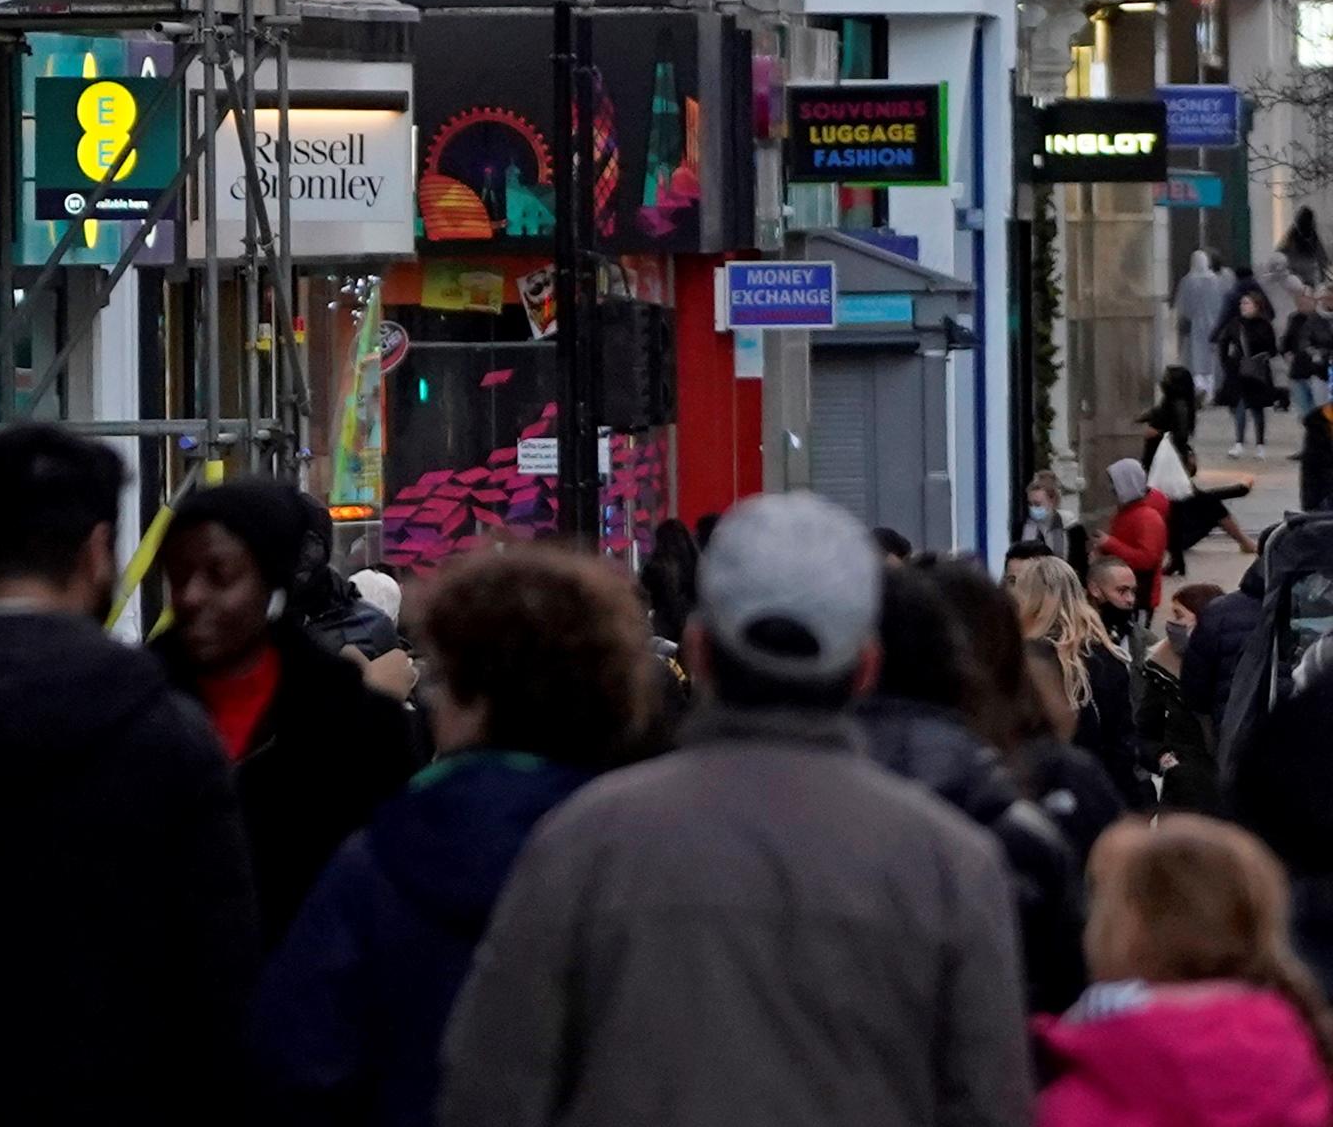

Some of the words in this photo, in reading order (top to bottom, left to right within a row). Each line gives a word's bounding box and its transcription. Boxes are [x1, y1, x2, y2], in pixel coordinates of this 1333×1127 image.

[799, 101, 926, 120] SOUVENIRS
[809, 124, 917, 144] LUGGAGE
[1045, 132, 1157, 156] INGLOT
[253, 130, 365, 166] Rssell
[813, 148, 915, 168] FASHION
[746, 268, 814, 285] MONEY
[732, 289, 830, 305] EXCHANGE
